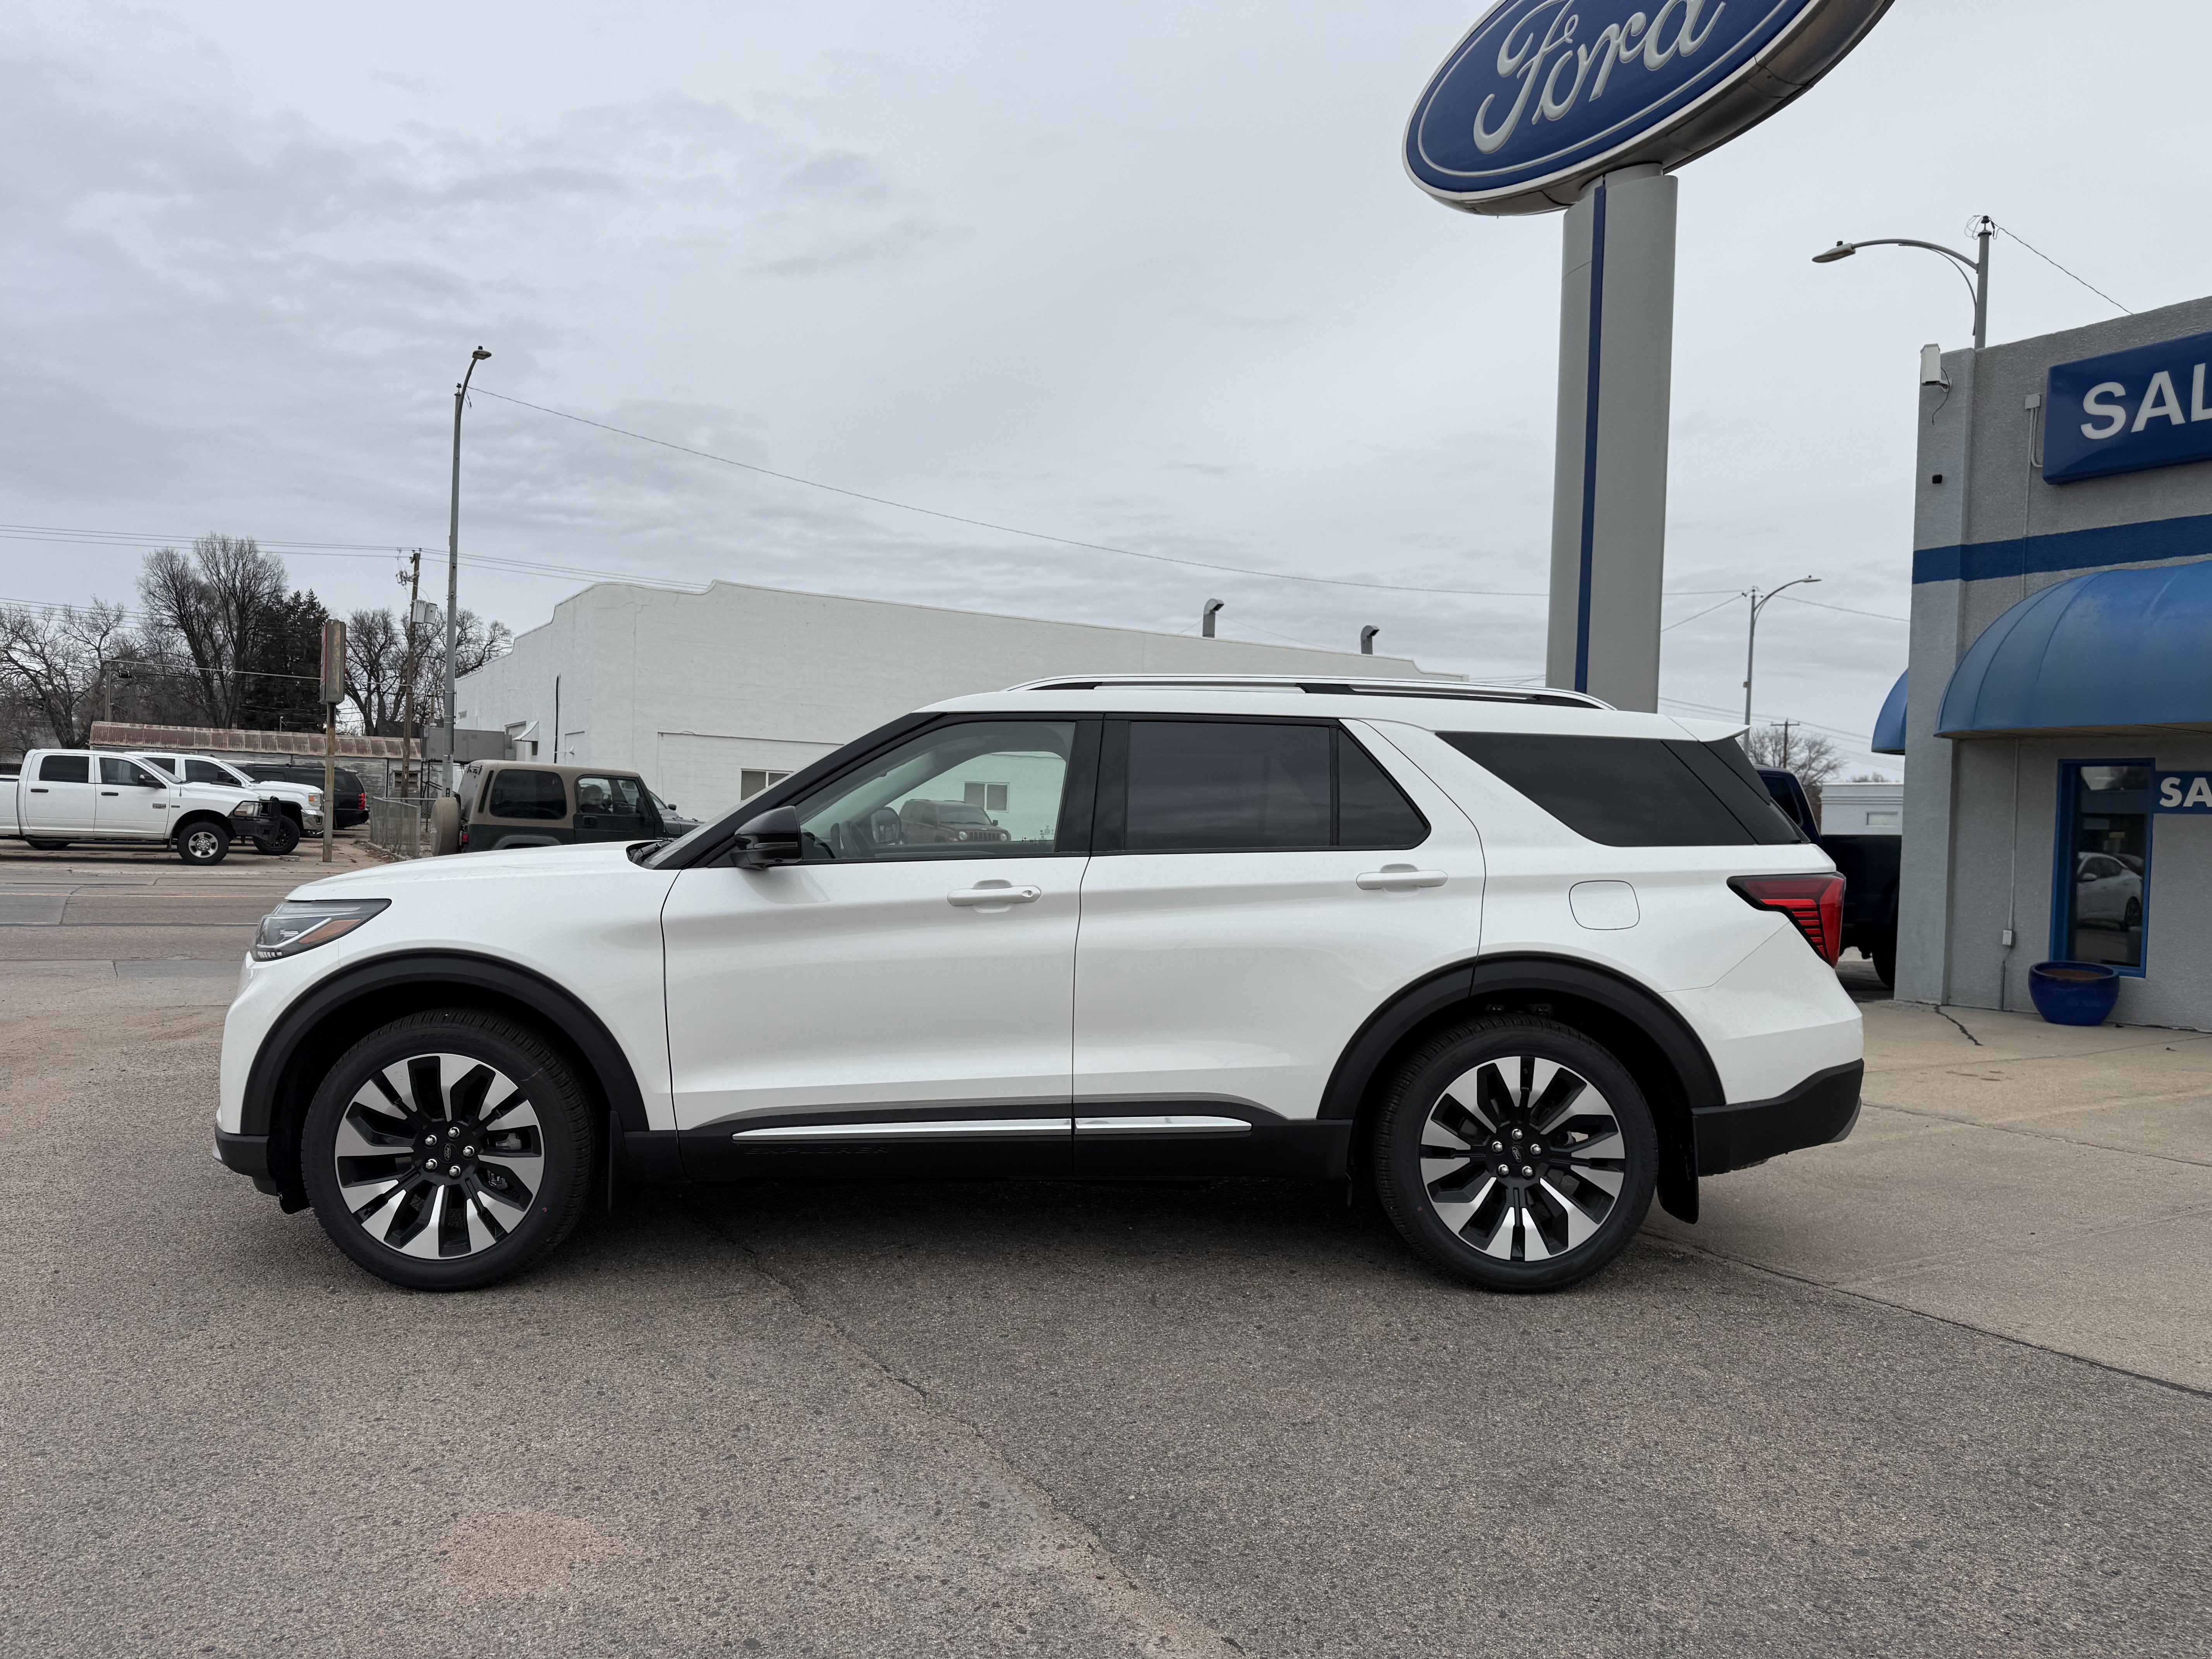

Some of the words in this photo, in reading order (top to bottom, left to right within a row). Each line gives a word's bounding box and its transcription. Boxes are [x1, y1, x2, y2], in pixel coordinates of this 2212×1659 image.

[1474, 0, 1726, 154] Ford
[2080, 362, 2212, 440] SAL
[2159, 777, 2212, 807] SA
[744, 1147, 890, 1155] EXPLORER
